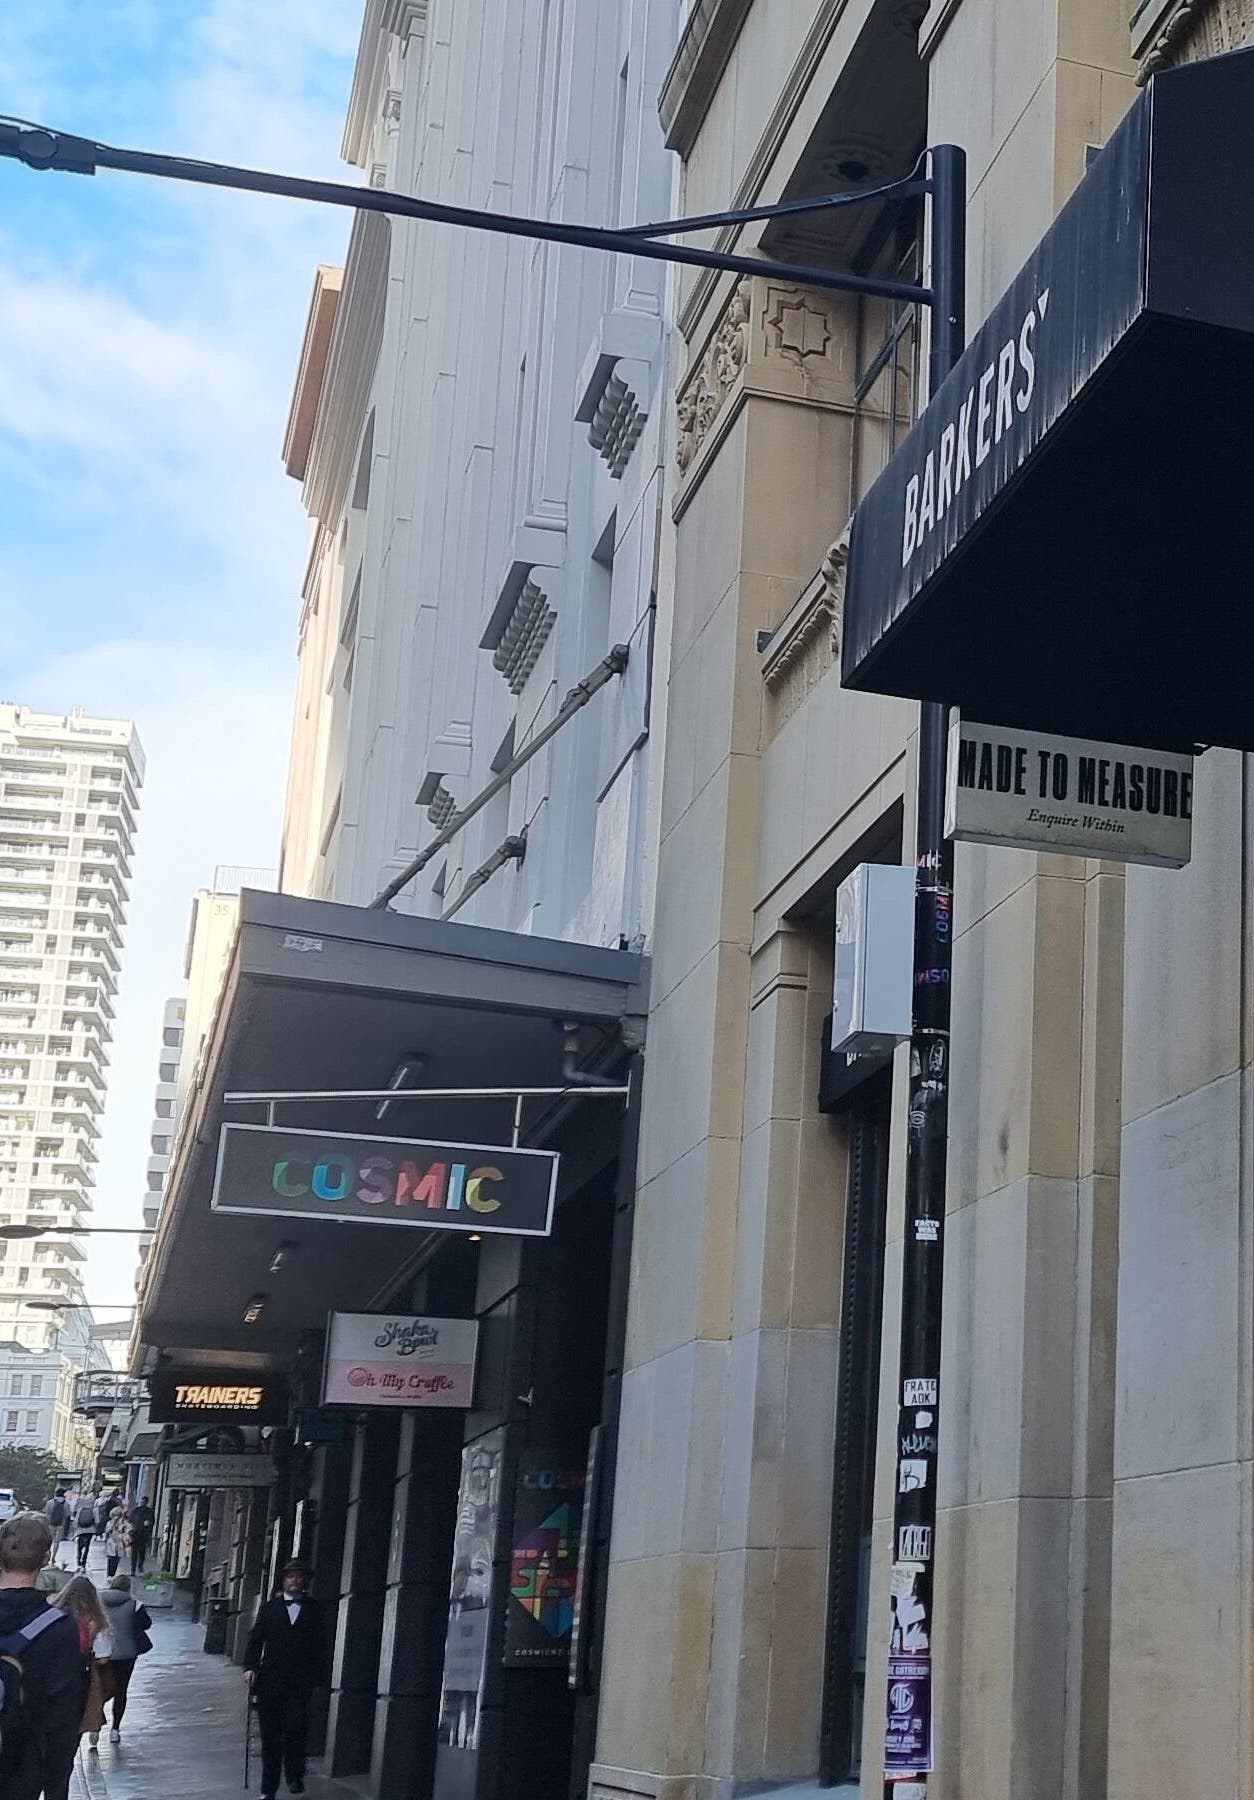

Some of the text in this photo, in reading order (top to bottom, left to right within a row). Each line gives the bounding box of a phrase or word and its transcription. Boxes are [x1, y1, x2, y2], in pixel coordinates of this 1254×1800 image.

[957, 738, 1193, 820] MADE TO MEASURE
[1027, 808, 1126, 834] Enquire Within
[272, 1153, 503, 1214] COSMIC
[175, 1385, 263, 1404] TRAINERS
